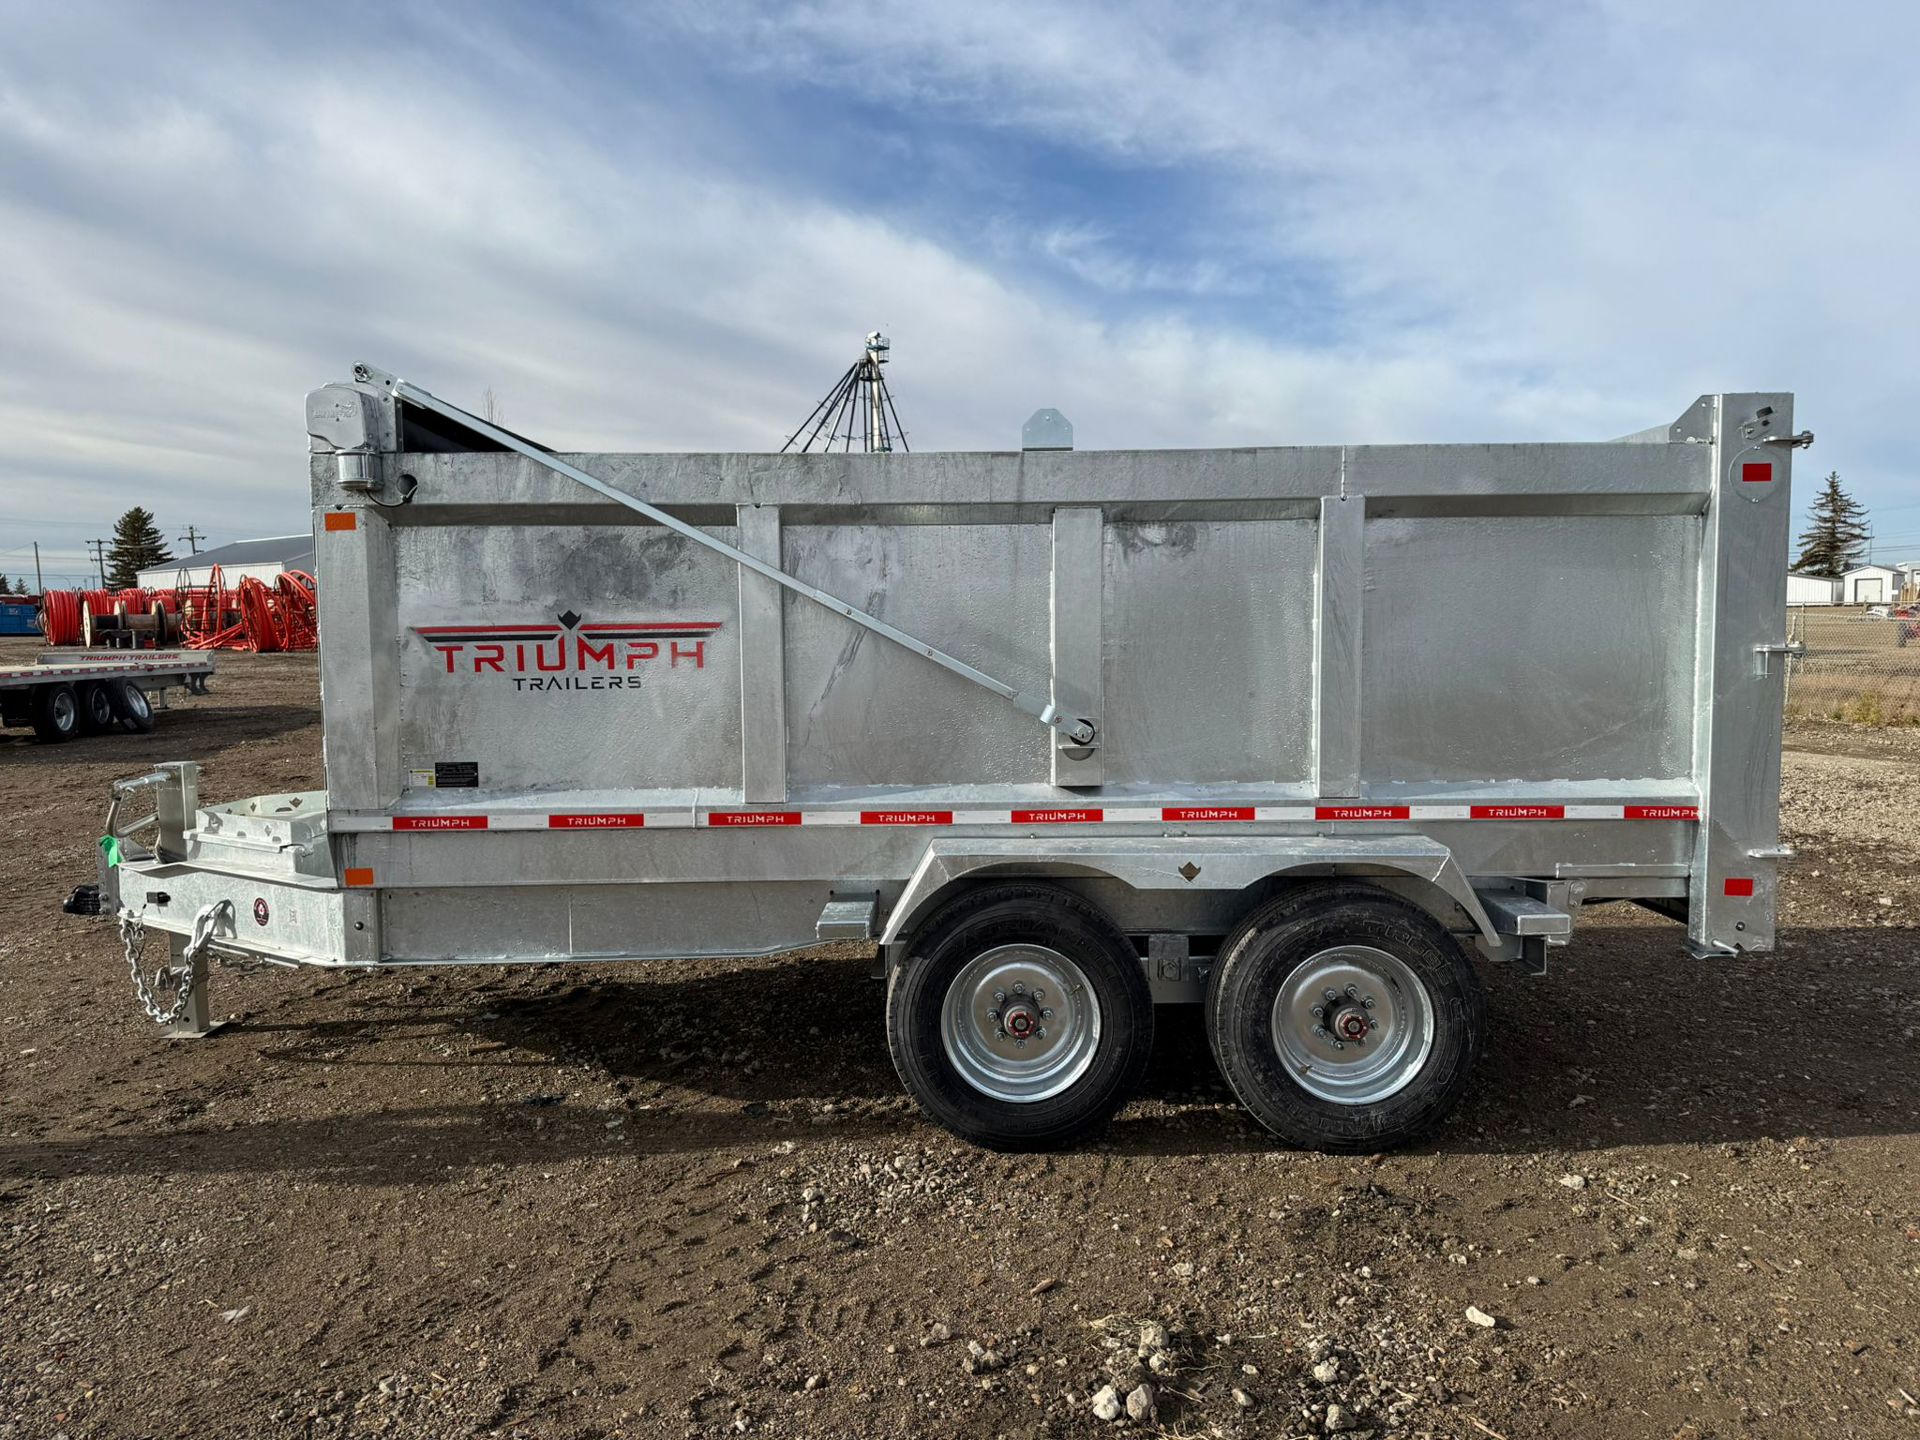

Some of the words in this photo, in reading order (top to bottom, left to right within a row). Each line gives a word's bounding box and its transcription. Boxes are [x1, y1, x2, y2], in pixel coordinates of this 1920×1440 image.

[80, 653, 127, 661] TRIUMPH
[434, 635, 705, 673] TRIUMPH
[512, 676, 641, 691] TRAILERS
[1028, 811, 1086, 821] TRIUMPH
[1179, 810, 1237, 819] TRIUMPH
[1333, 808, 1392, 818] TRIUMPH
[1488, 807, 1547, 817] TRIUMPH
[1642, 808, 1699, 817] TRIUMPH
[411, 818, 470, 828] TRIUMPH
[567, 816, 626, 826] TRIUMPH
[726, 814, 784, 824] TRIUMPH
[878, 813, 935, 823] TRIUMPH
